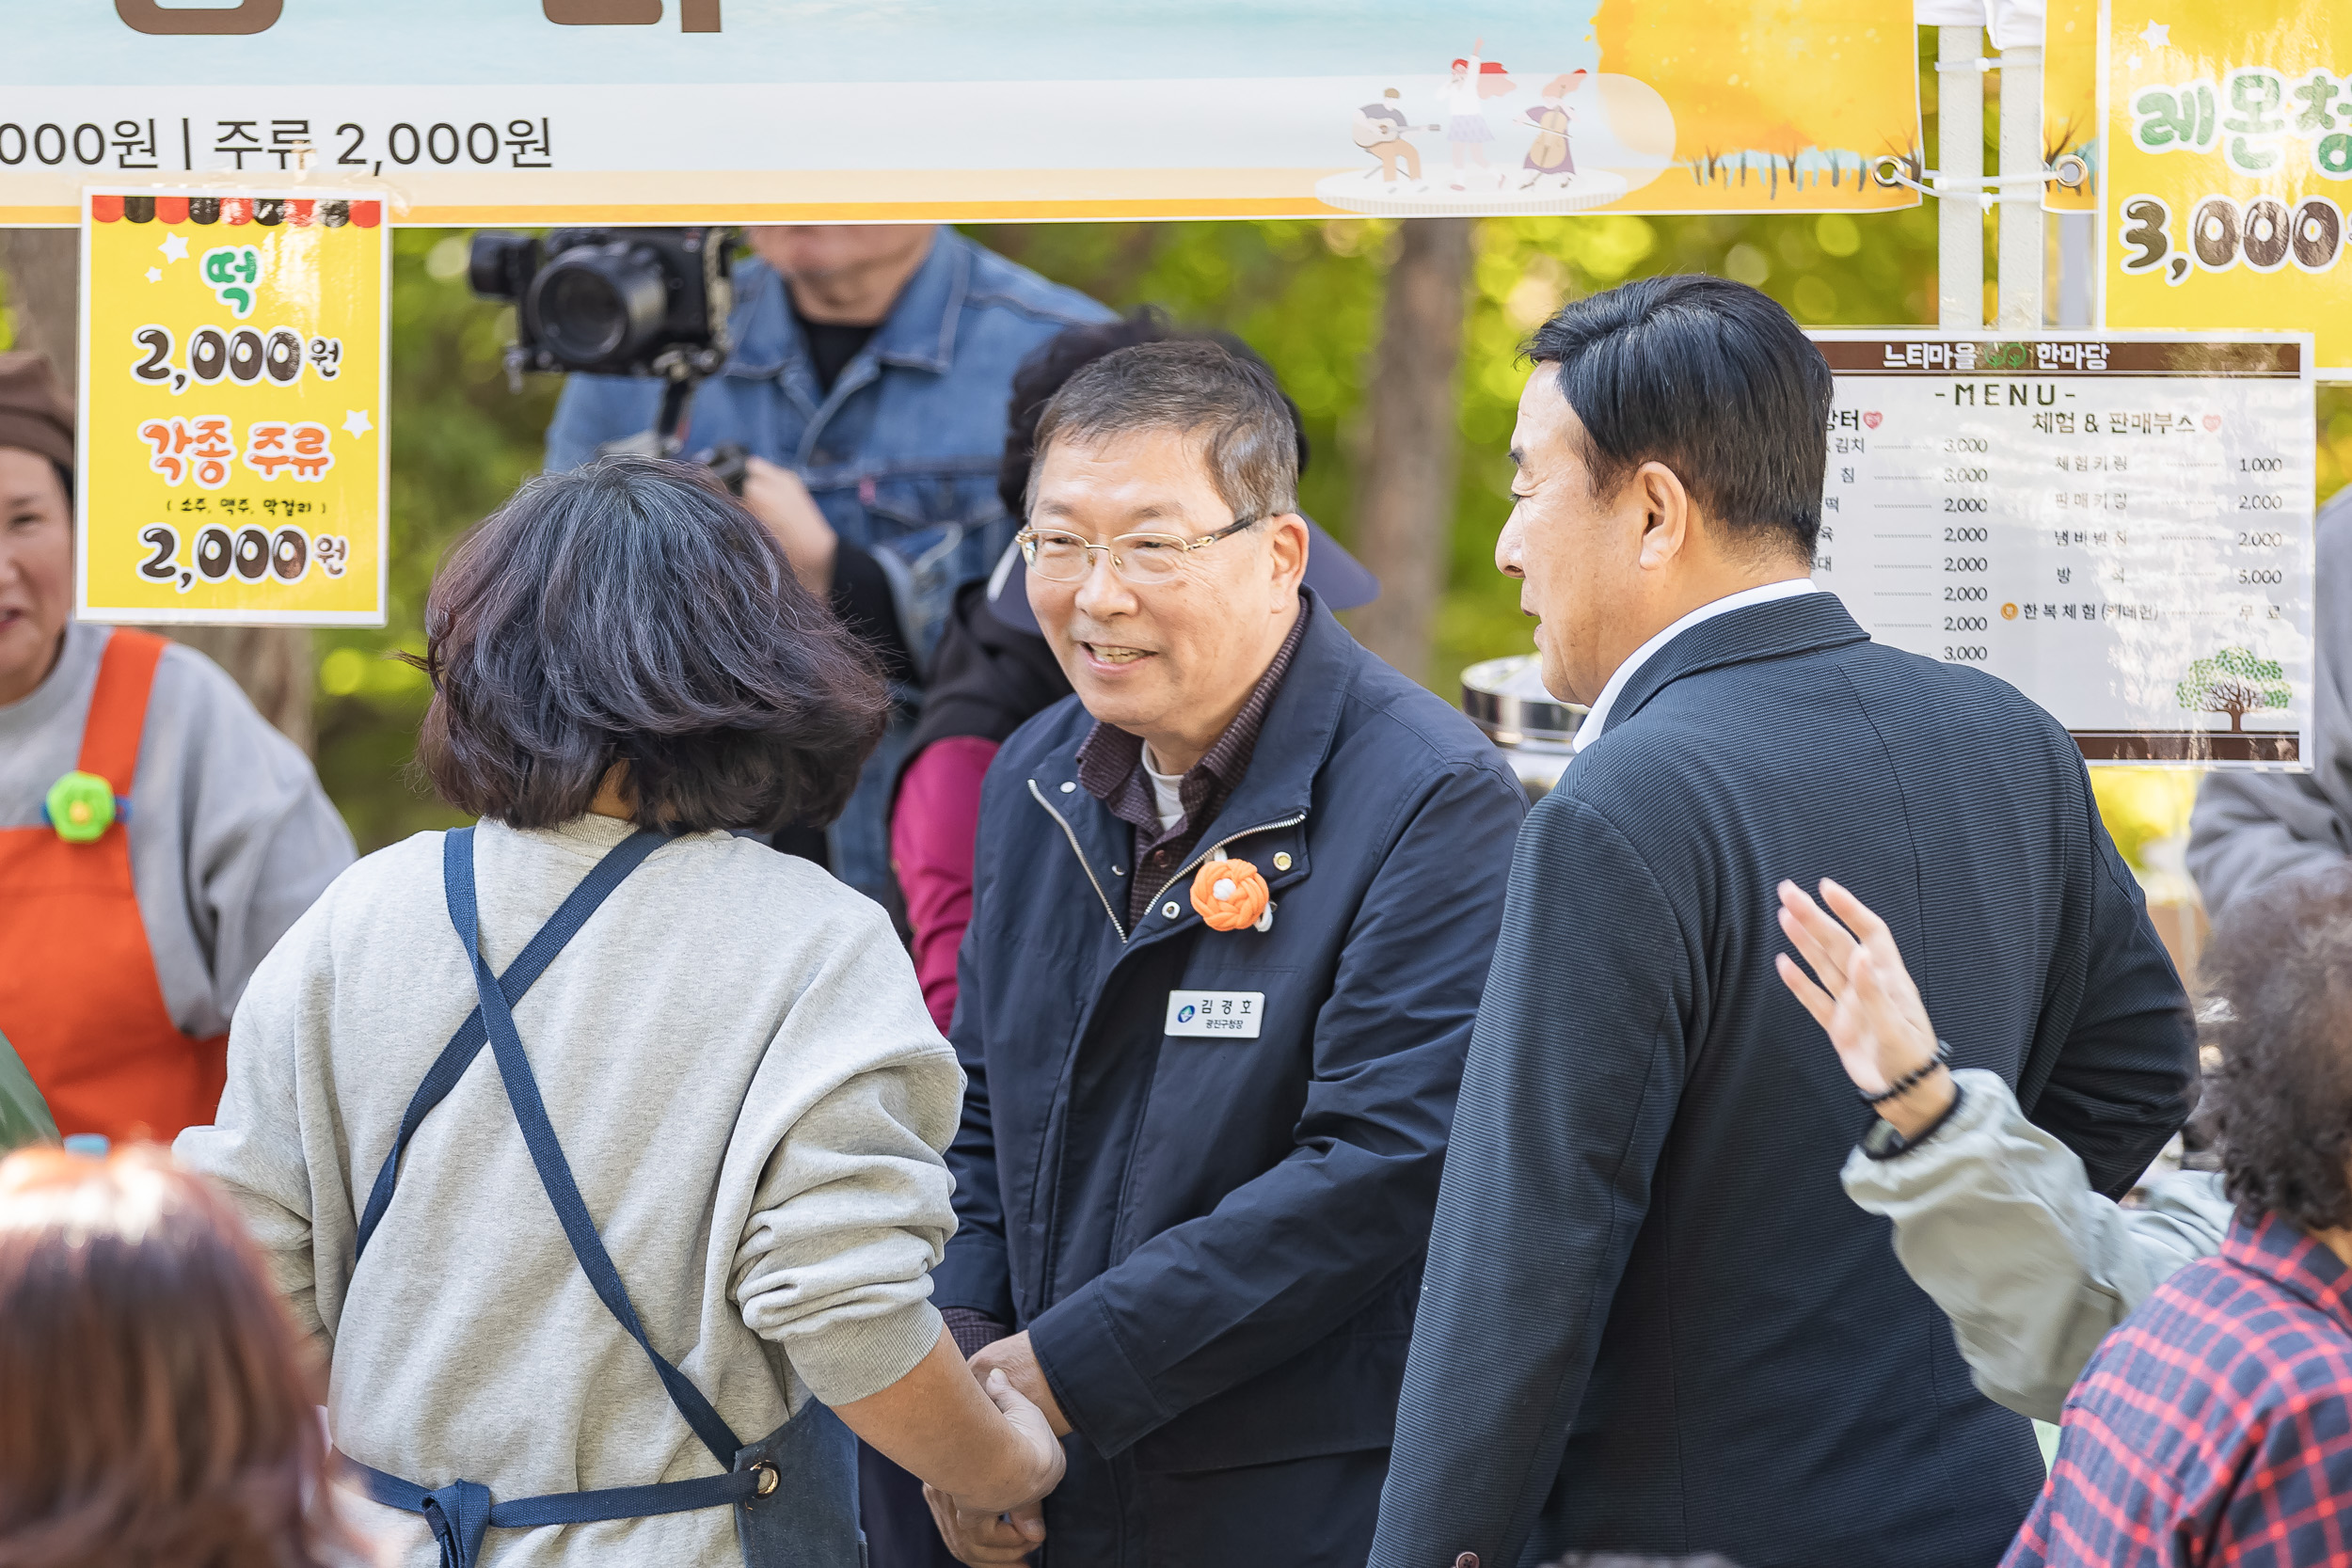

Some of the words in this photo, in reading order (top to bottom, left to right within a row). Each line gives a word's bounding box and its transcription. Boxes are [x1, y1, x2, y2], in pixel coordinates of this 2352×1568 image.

[214, 119, 318, 170] 주류
[335, 117, 553, 177] 2,000원
[2125, 200, 2352, 280] 3,000
[206, 250, 258, 313] 떡
[135, 329, 340, 391] 2,000원
[1883, 342, 1977, 370] 느티마을
[2037, 342, 2110, 370] 한마당
[2032, 411, 2075, 434] 체험
[2084, 412, 2100, 434] &
[2108, 412, 2196, 434] 판매부스
[143, 420, 232, 485] 각종
[248, 427, 329, 478] 주류
[1944, 437, 1988, 454] 3,000
[2239, 457, 2283, 473] 1,000
[1944, 498, 1988, 514] 2,000
[2238, 495, 2283, 511] 2,000
[1944, 527, 1988, 544] 2,000
[2238, 532, 2283, 548] 2,000
[141, 528, 346, 589] 2,000원
[1944, 557, 1988, 573] 2,000
[2238, 569, 2283, 586] 5,000
[1944, 586, 1988, 603] 2,000
[1944, 616, 1988, 632] 2,000
[1944, 645, 1988, 661] 3,000
